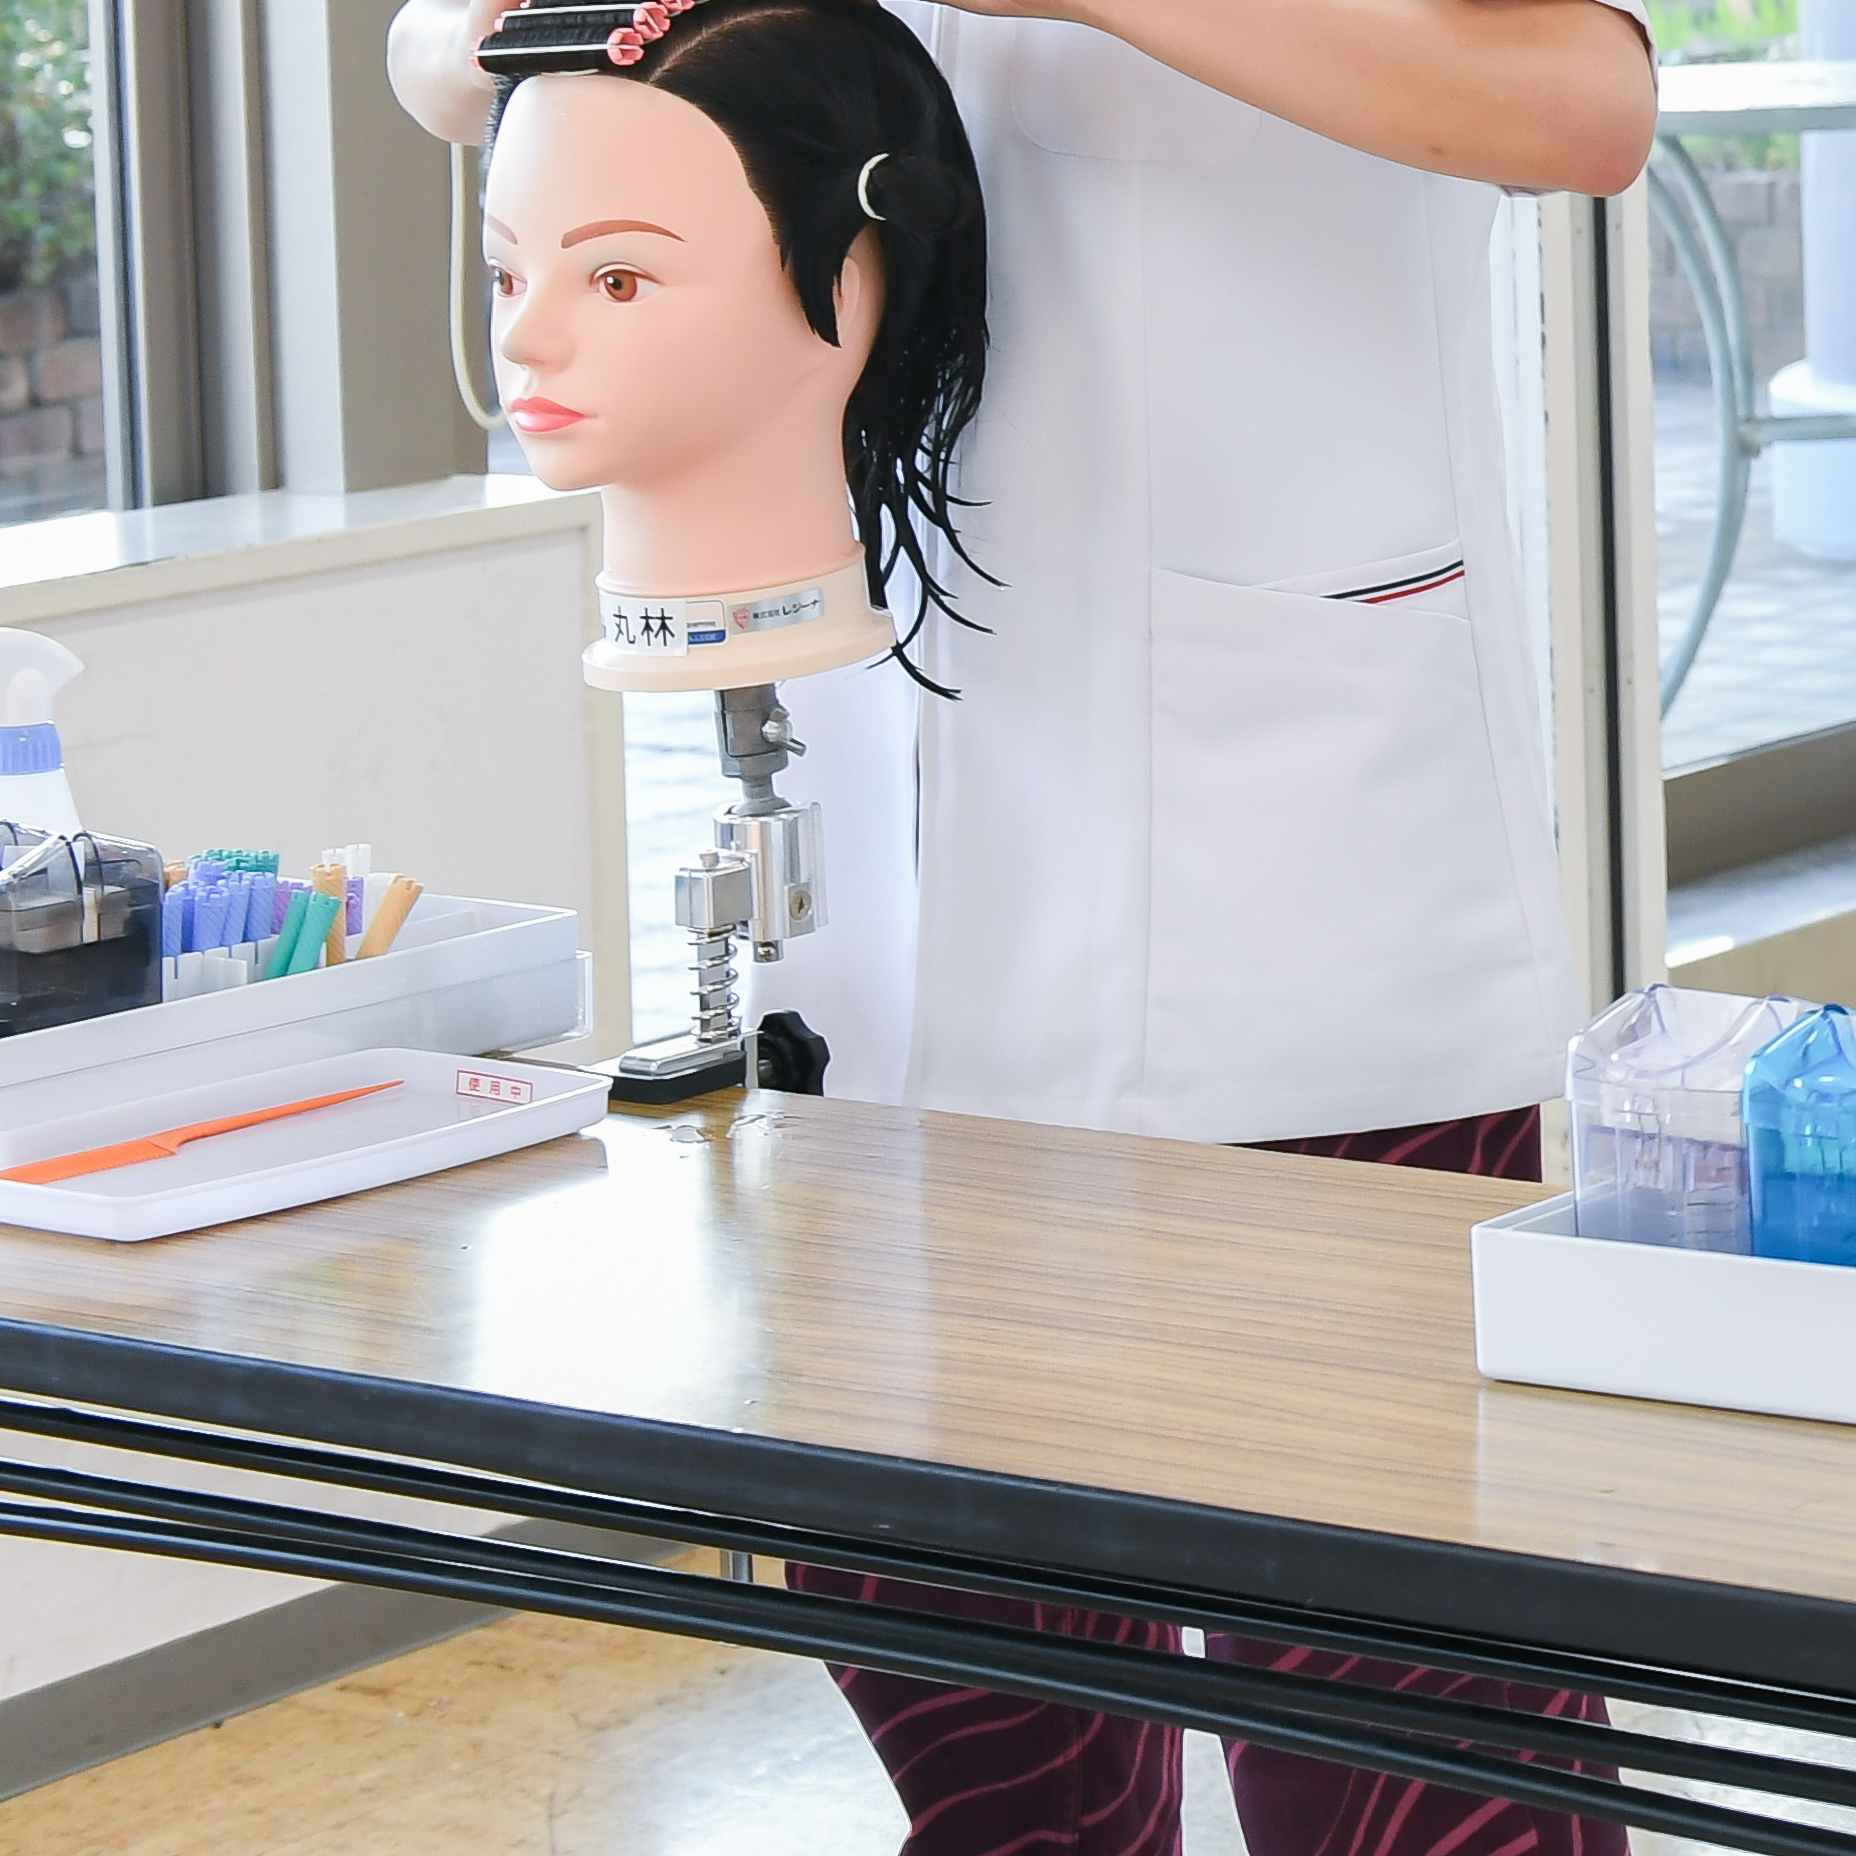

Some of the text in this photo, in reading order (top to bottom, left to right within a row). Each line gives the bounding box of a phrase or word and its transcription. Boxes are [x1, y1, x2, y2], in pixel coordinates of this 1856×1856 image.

[612, 605, 675, 646] 丸林
[468, 1077, 521, 1099] 使用中
